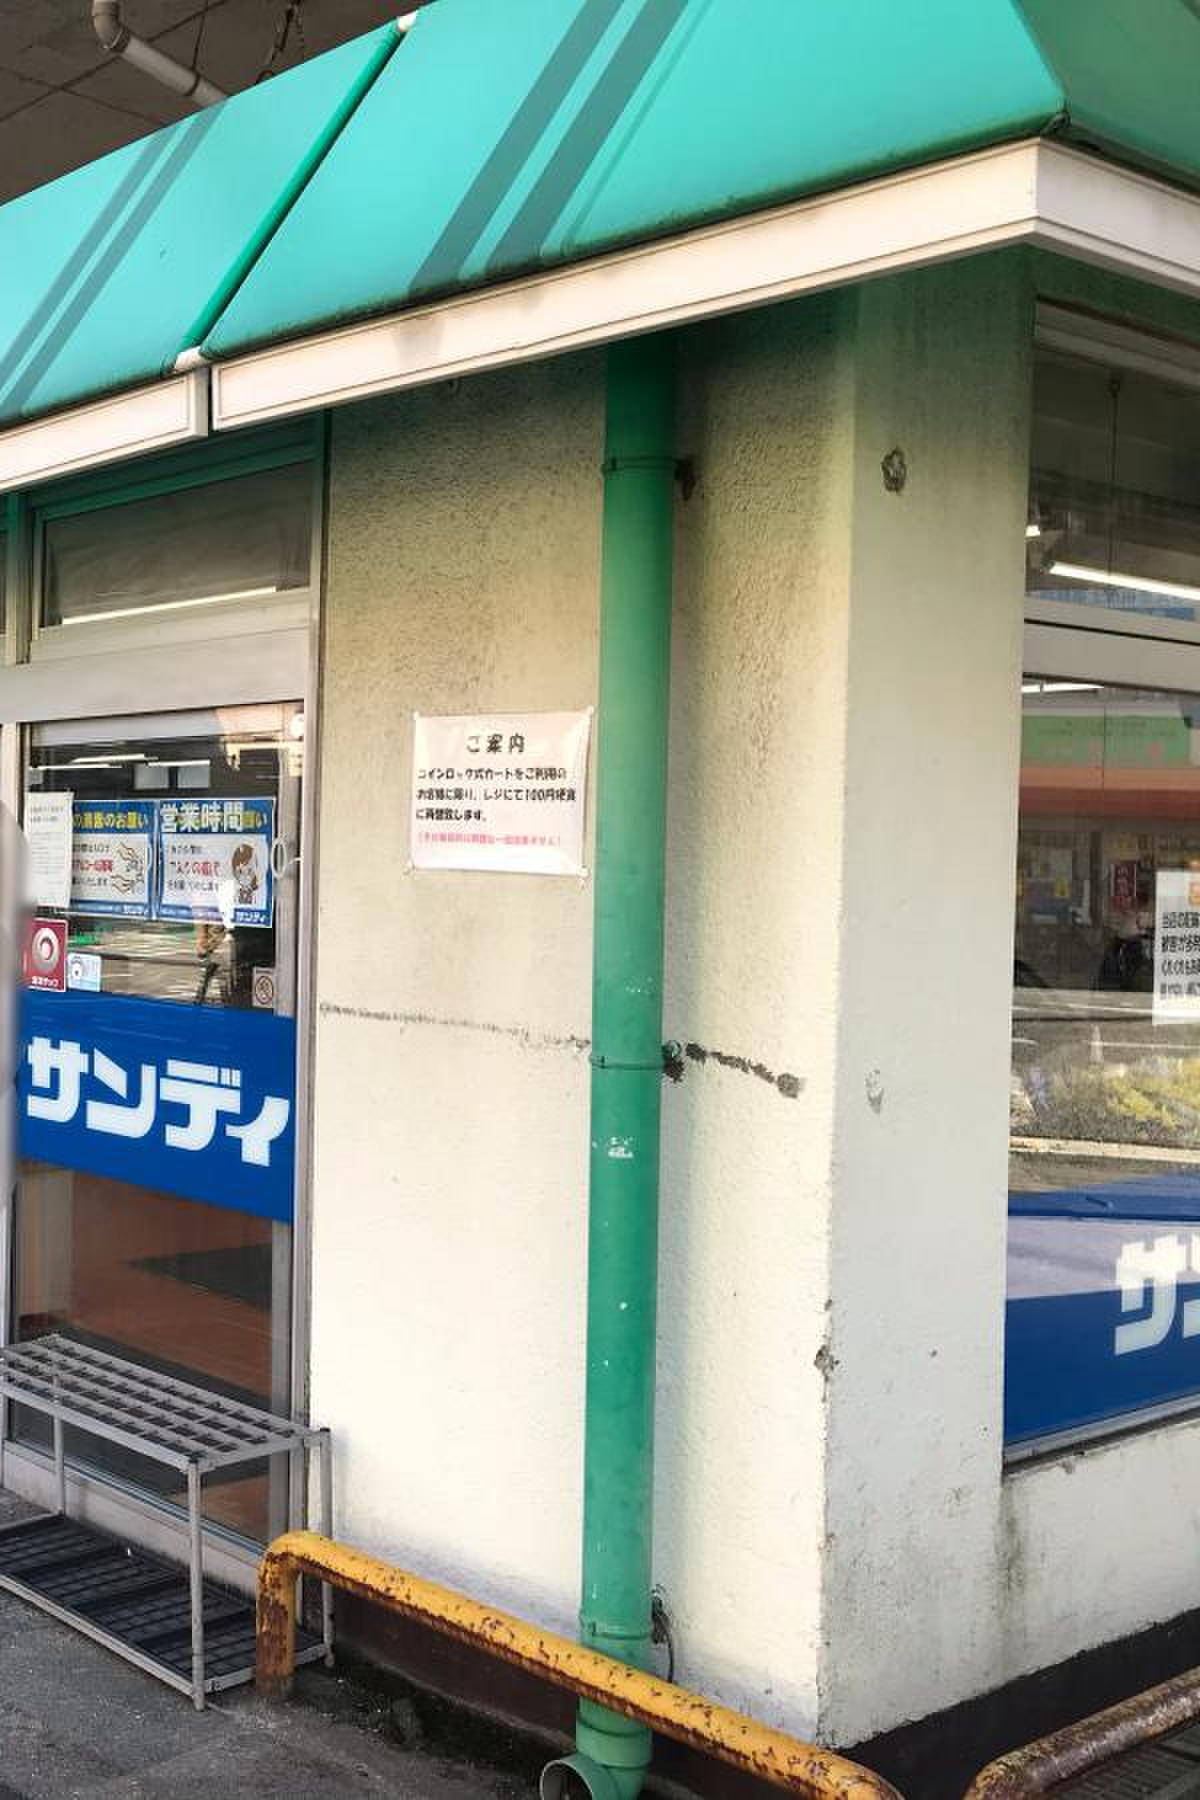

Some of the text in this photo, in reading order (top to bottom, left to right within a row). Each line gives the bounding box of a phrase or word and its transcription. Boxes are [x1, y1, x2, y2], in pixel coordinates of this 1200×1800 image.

[466, 732, 525, 754] ご案内
[160, 801, 244, 832] 営業時間
[27, 1036, 290, 1168] サンディ
[1115, 1231, 1200, 1357] サ
